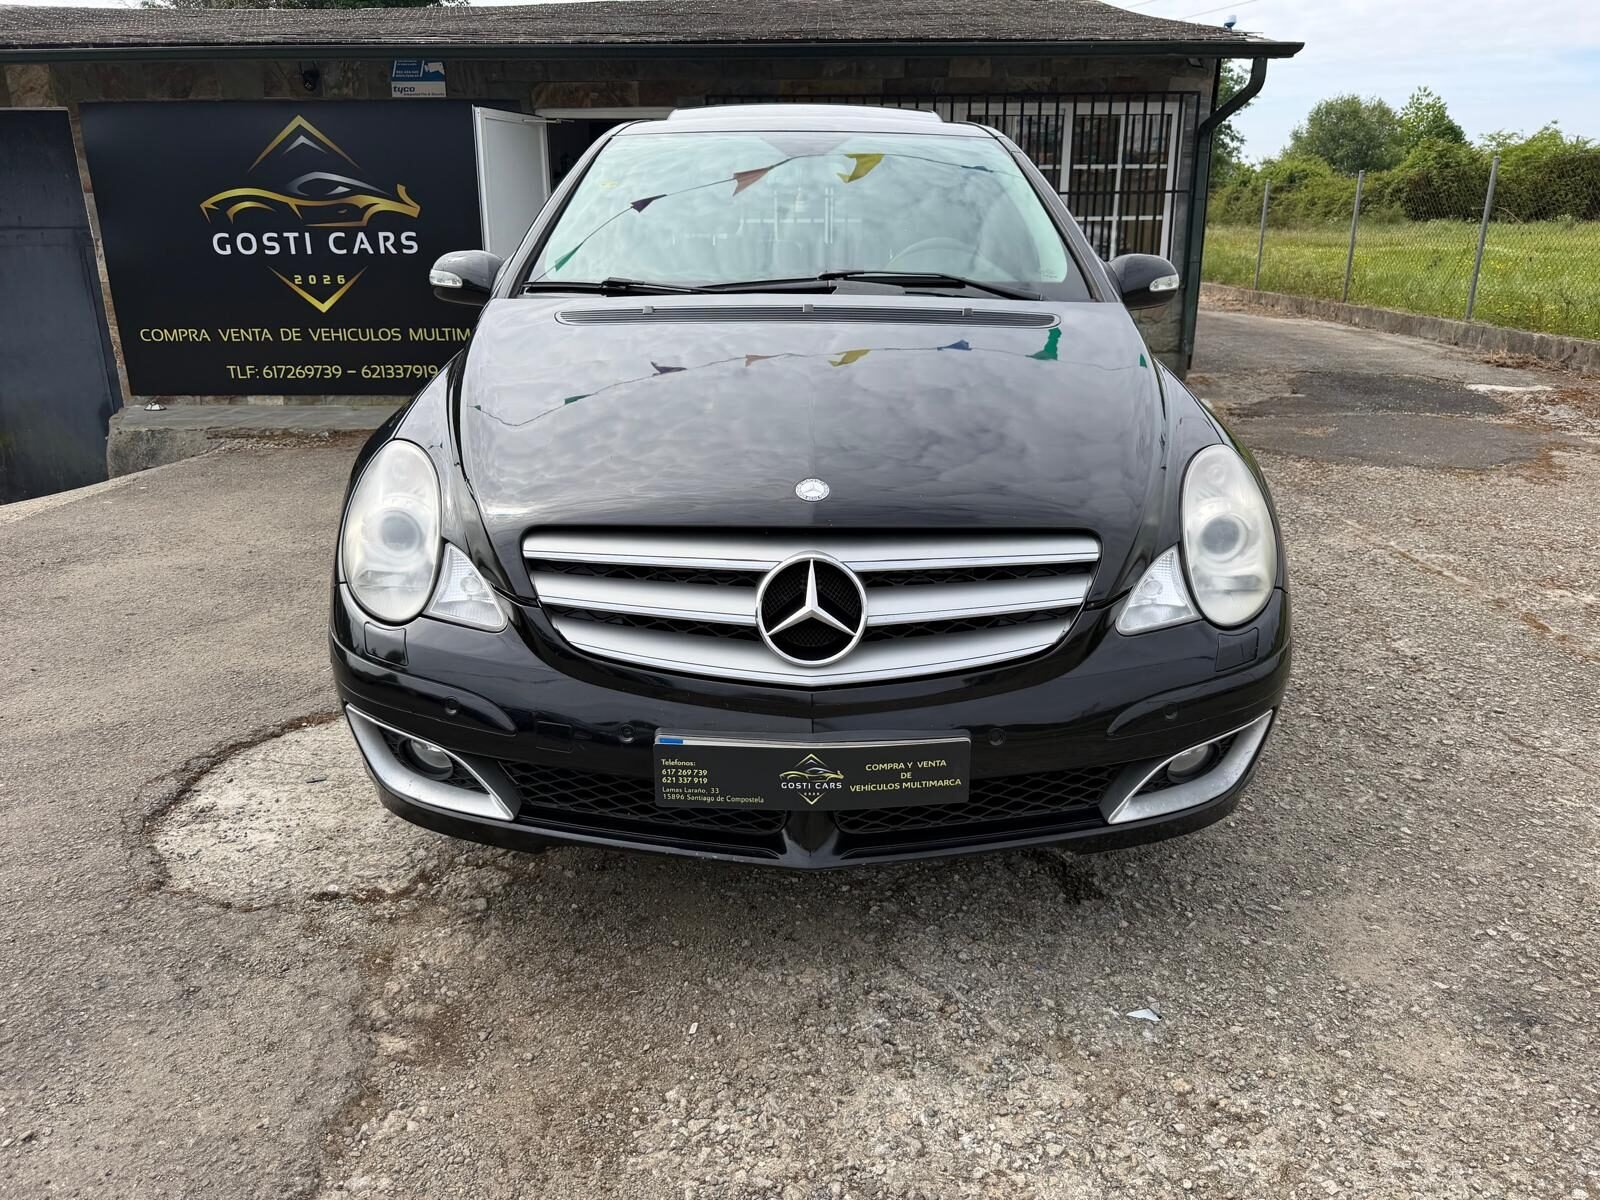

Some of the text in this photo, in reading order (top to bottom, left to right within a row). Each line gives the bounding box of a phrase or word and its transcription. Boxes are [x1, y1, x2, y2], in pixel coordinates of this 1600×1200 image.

[393, 86, 416, 94] tyco
[212, 231, 419, 255] GOSTI CARS
[294, 274, 346, 285] 2026
[139, 328, 212, 342] COMPRA
[218, 328, 274, 342] VENTA
[280, 328, 303, 342] DE
[308, 328, 402, 342] VEHICULOS
[226, 365, 260, 379] TLF:
[262, 365, 343, 379] 617269739
[361, 365, 439, 379] 621337919
[865, 759, 947, 772] COMPRA Y VENTA
[661, 768, 676, 776] 617
[693, 769, 708, 777] 739
[661, 776, 676, 784] 621
[693, 777, 708, 785] 919
[781, 782, 842, 790] GOSTI CARS
[849, 778, 962, 793] VEHÍCULOS MULTIMARCA
[663, 793, 685, 801] 15896
[686, 794, 714, 803] Santiago
[716, 795, 725, 803] de
